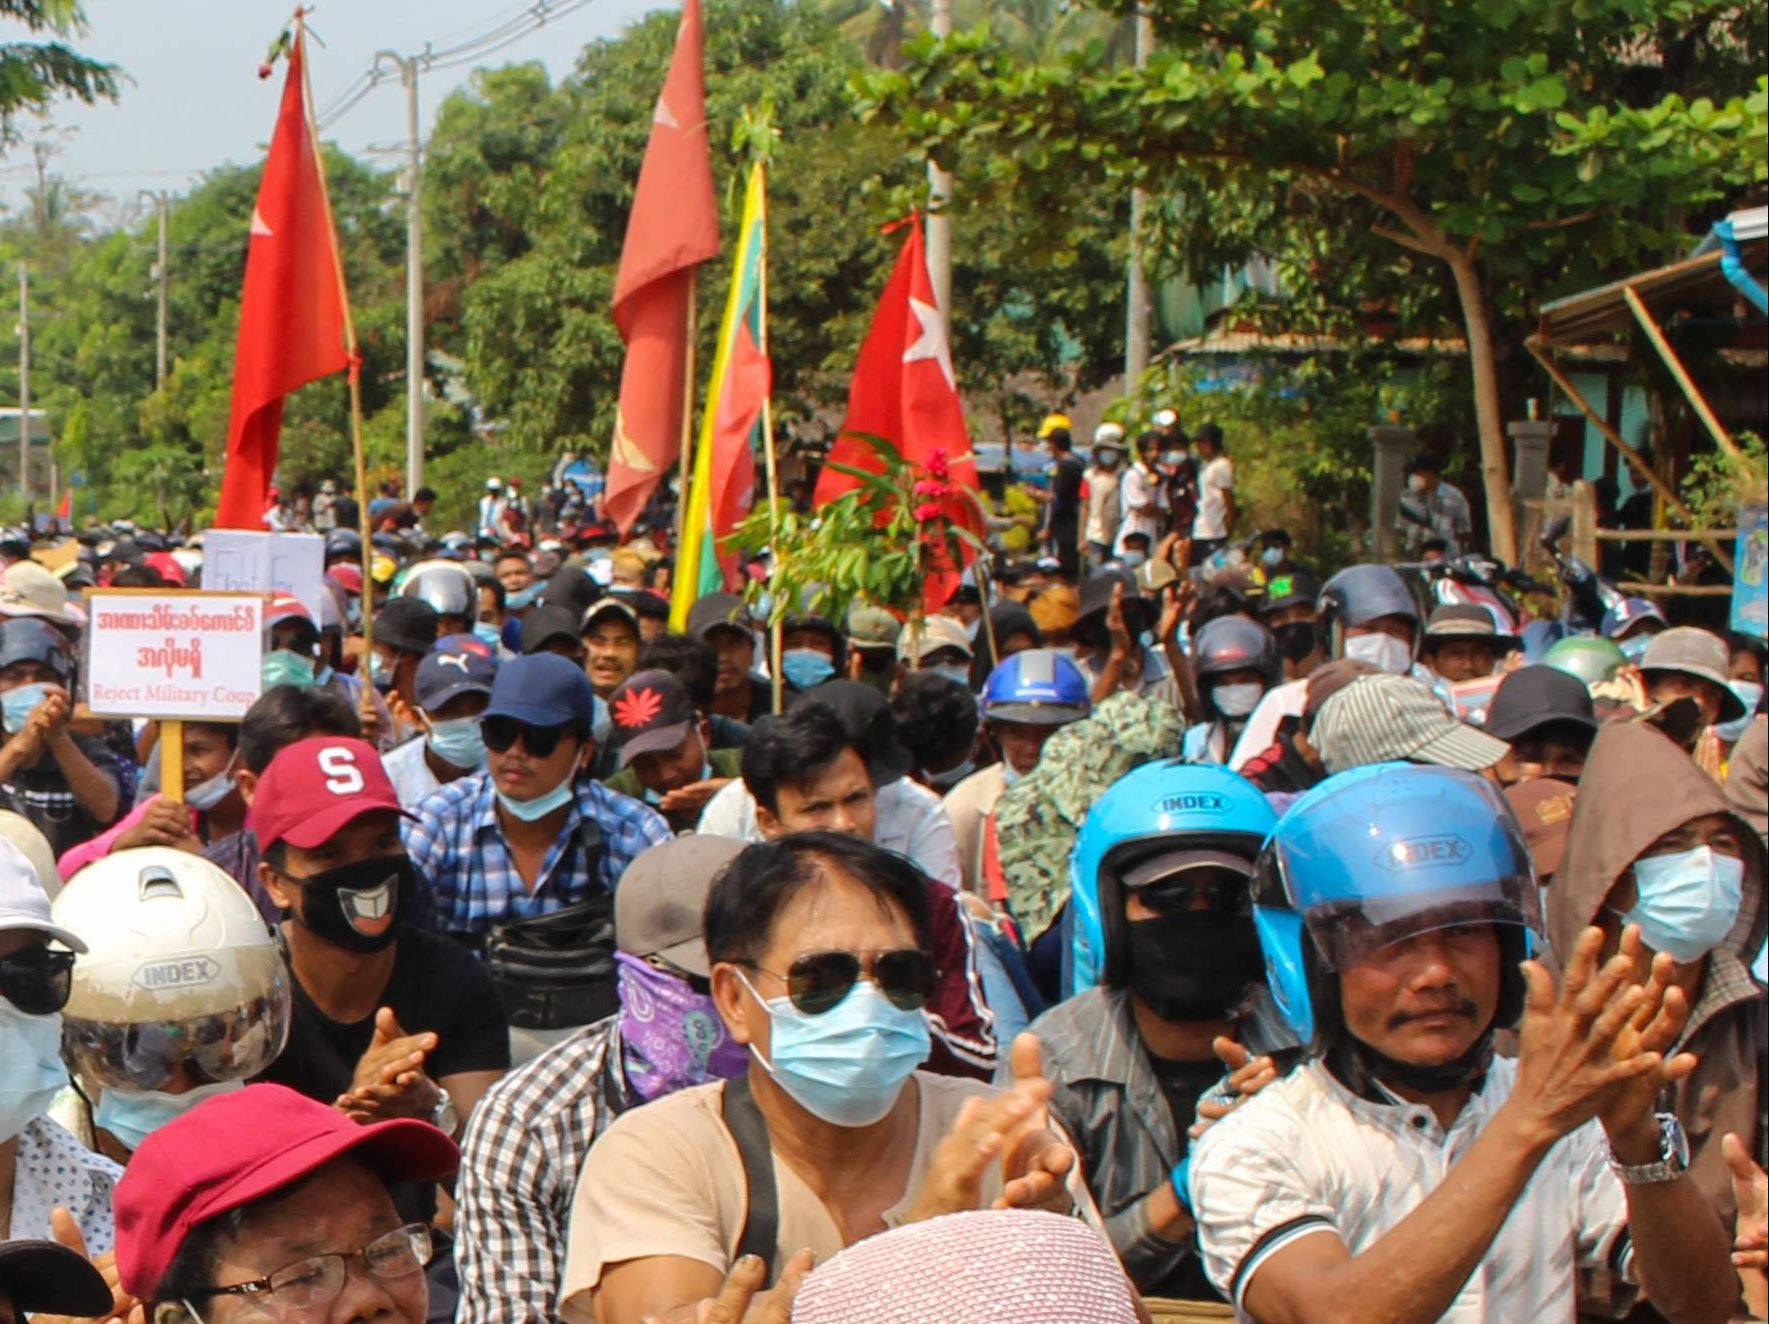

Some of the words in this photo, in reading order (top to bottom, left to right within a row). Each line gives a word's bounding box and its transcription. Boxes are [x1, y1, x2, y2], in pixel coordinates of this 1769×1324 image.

[93, 684, 141, 704] Reject
[145, 684, 209, 706] Military
[213, 686, 256, 706] Coup
[318, 746, 365, 795] S
[1162, 795, 1222, 812] INDEX
[144, 960, 209, 986] INDEX
